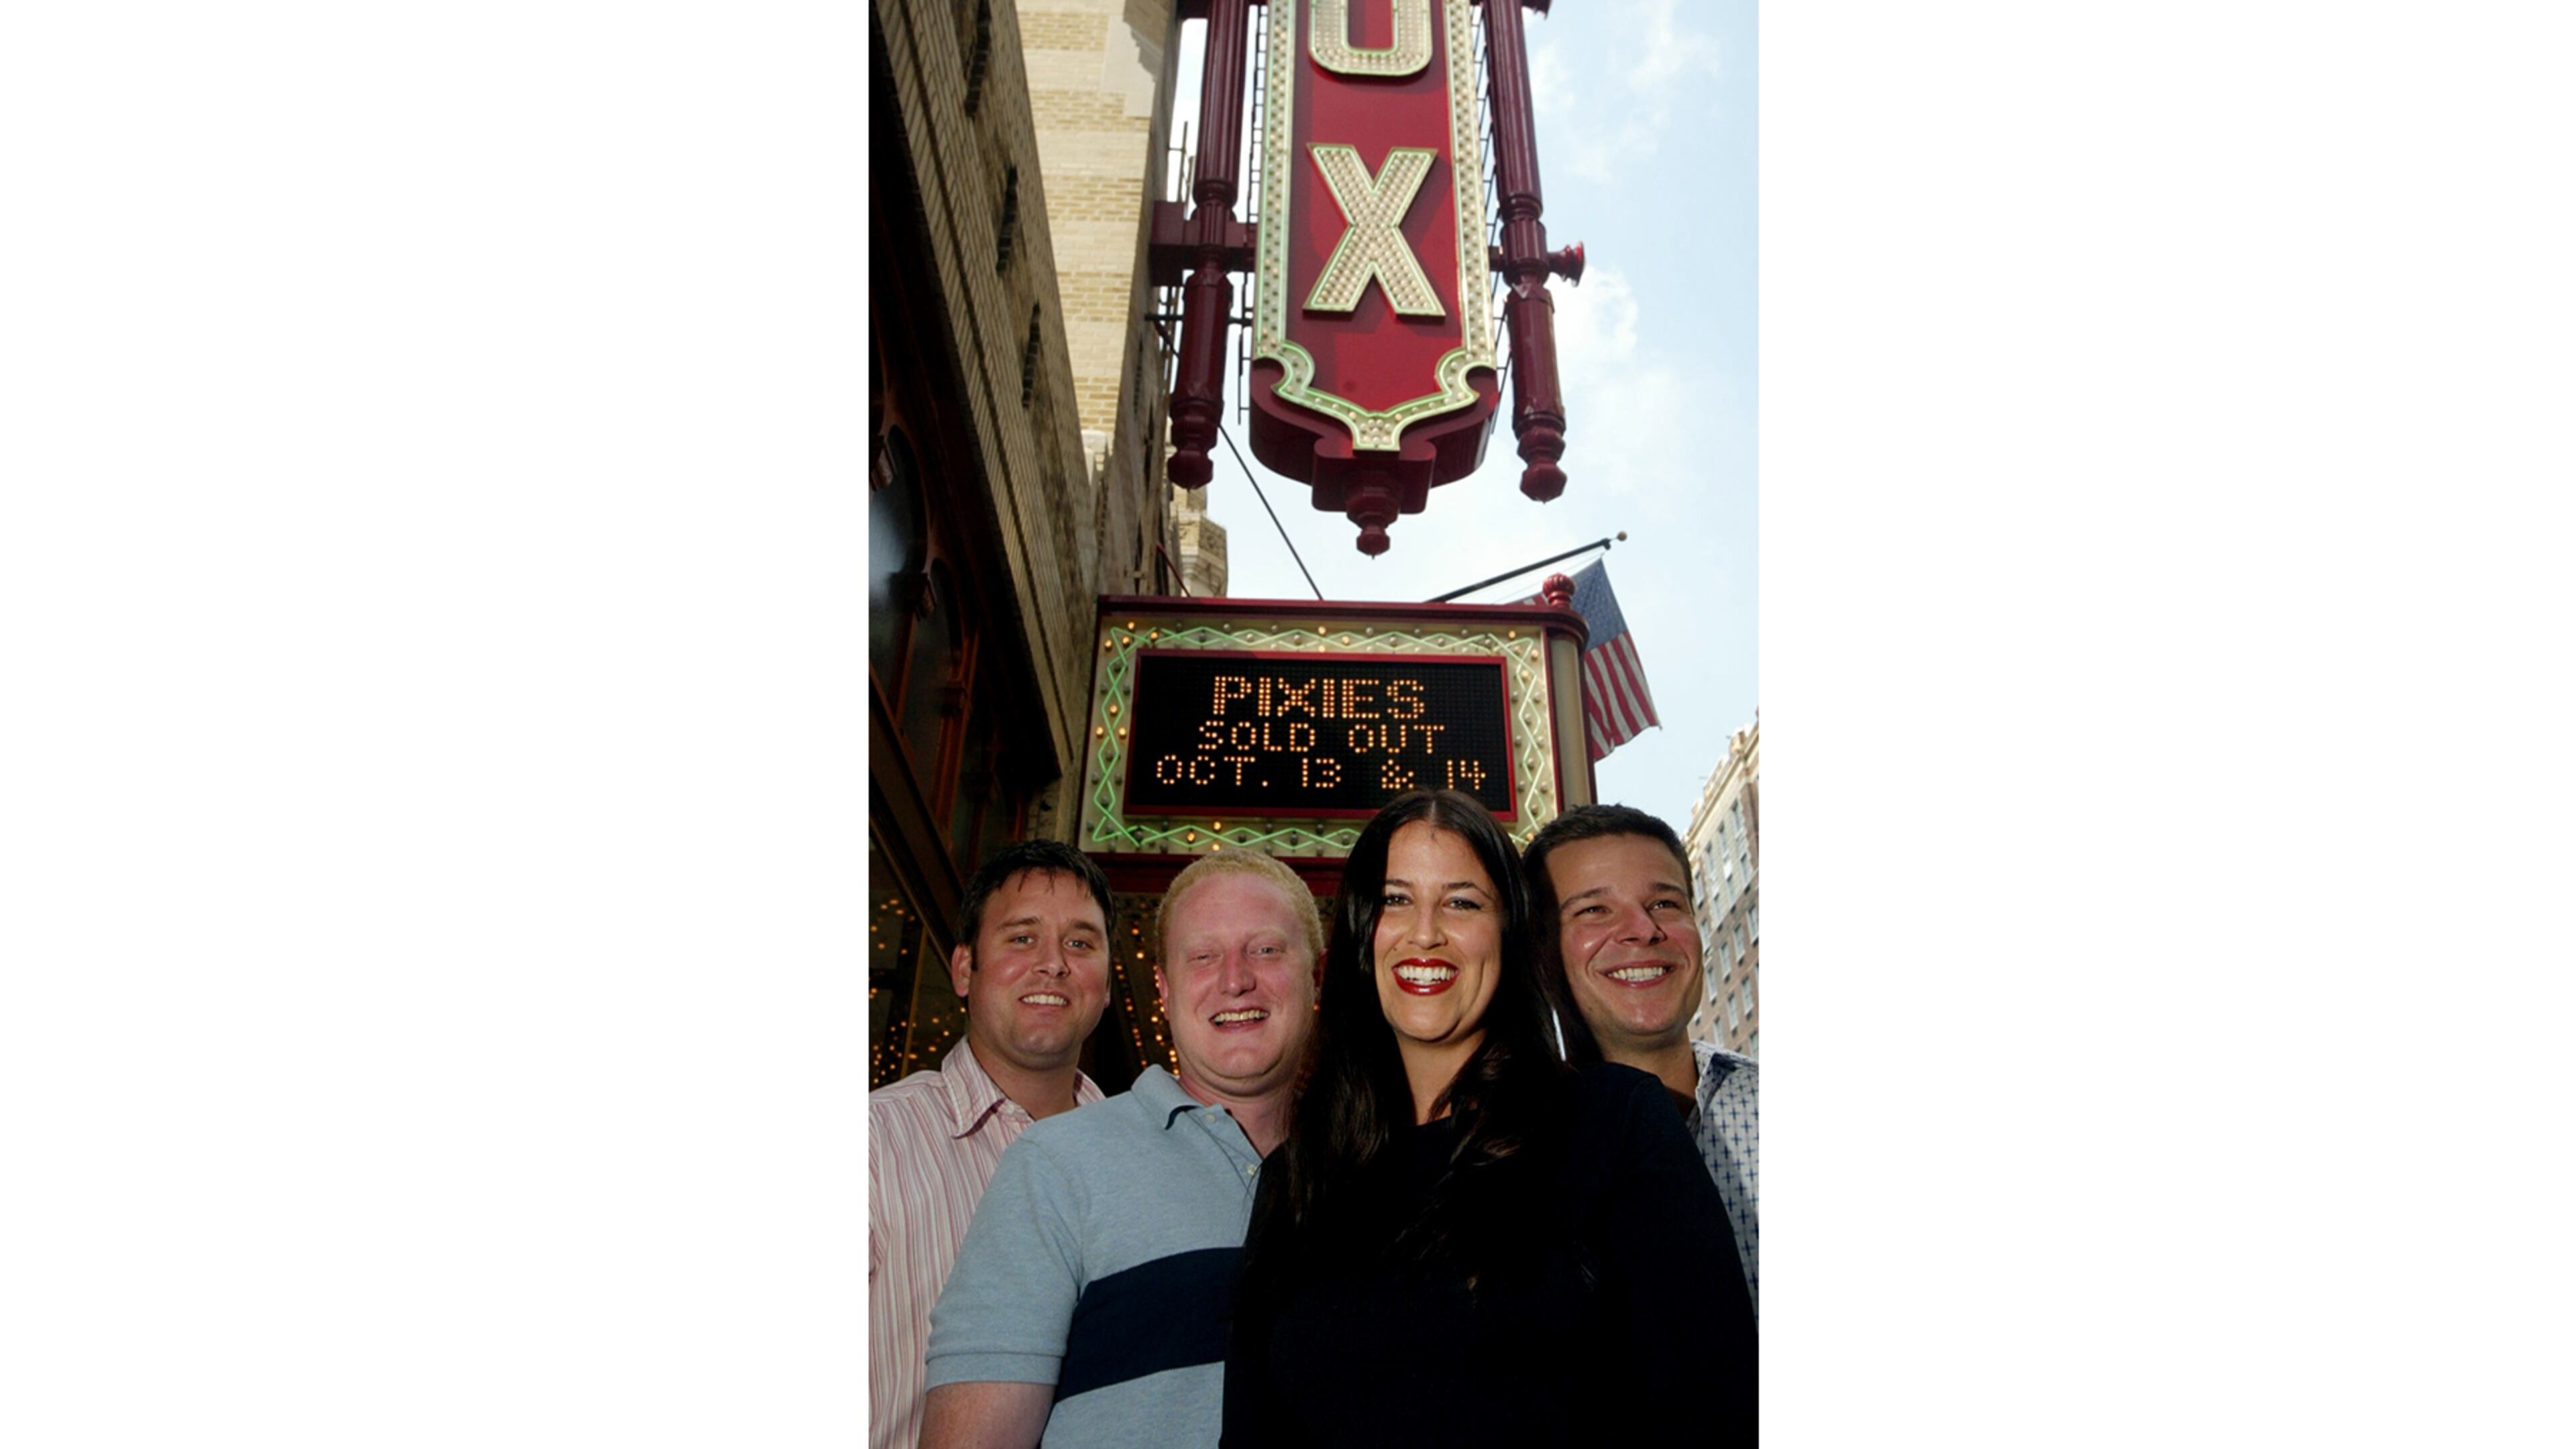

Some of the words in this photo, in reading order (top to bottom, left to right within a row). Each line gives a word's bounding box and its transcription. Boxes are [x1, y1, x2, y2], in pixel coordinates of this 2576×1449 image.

[1214, 676, 1424, 718] PIXIES
[1199, 720, 1315, 751] SOLD
[1349, 724, 1444, 753] OUT
[1157, 755, 1267, 786] OCT.
[1303, 758, 1340, 788] 13
[1382, 759, 1413, 789] &
[1447, 760, 1485, 790] 14
